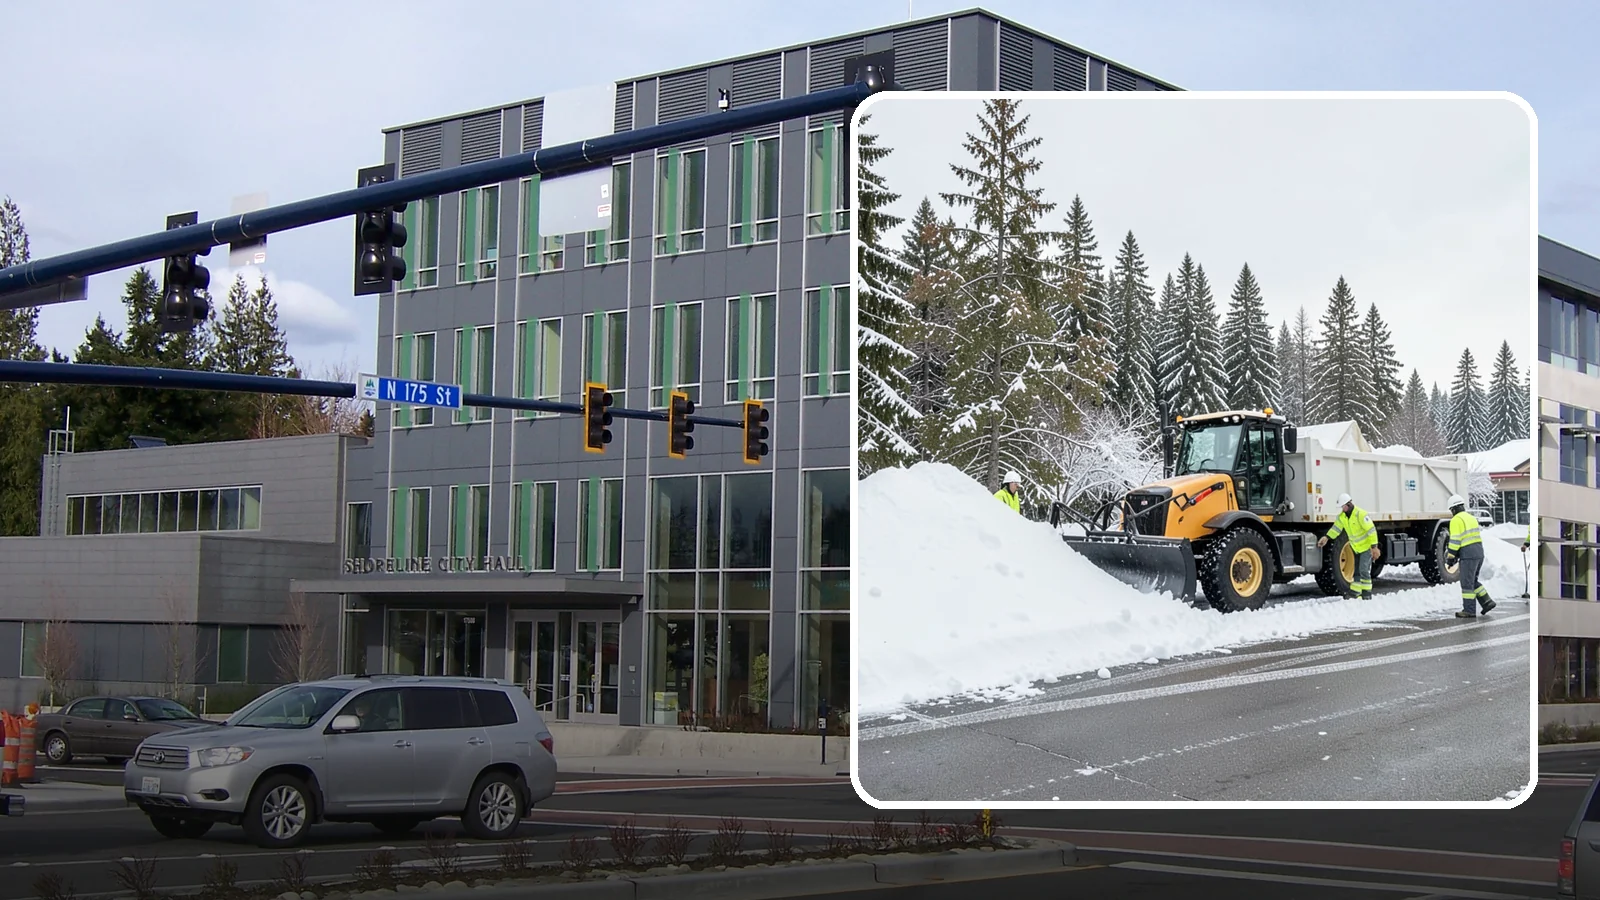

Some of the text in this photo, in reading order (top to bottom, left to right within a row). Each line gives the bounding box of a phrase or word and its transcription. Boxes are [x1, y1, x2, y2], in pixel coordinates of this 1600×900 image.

[387, 380, 452, 406] N 175 St
[344, 555, 526, 574] SHORELINE CITY HALL
